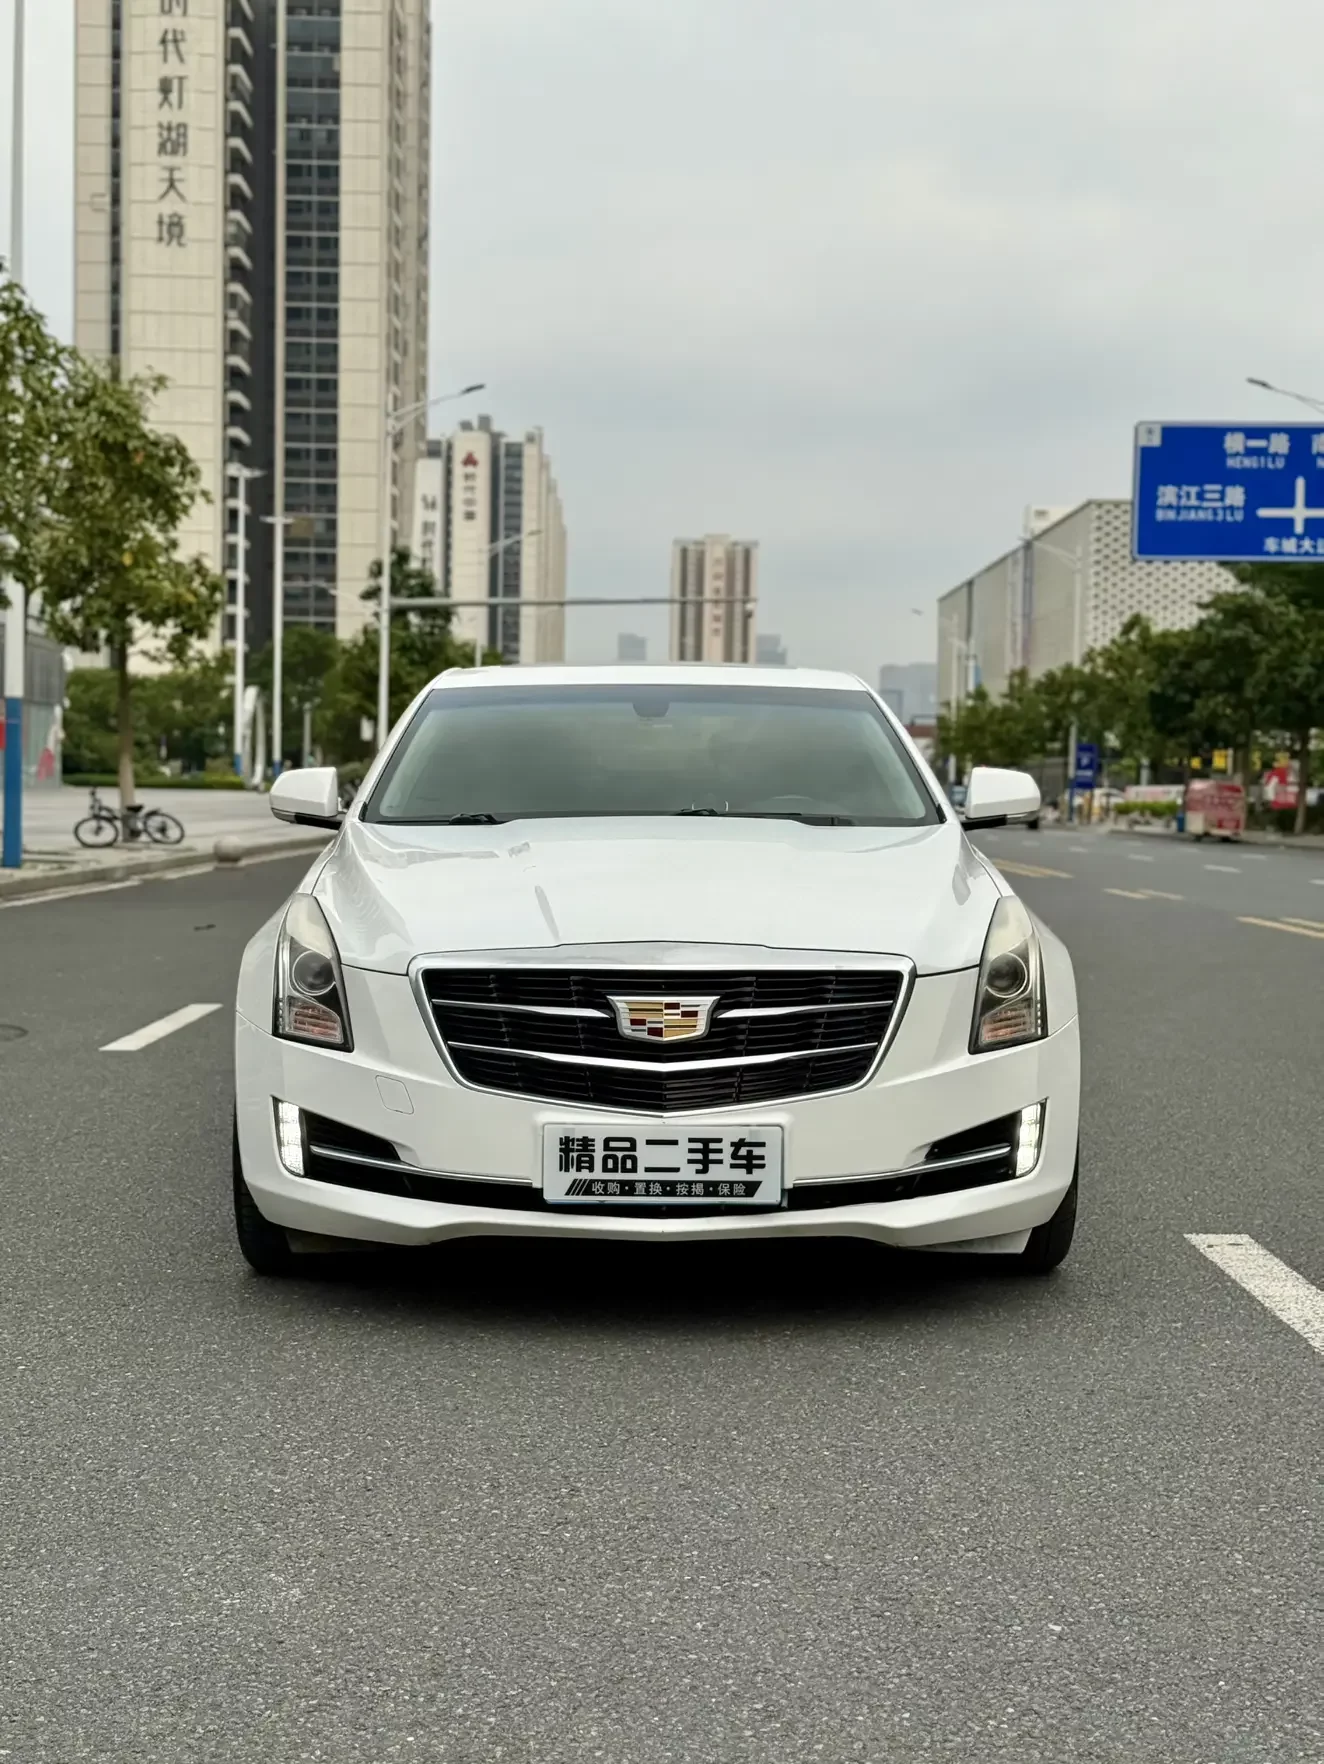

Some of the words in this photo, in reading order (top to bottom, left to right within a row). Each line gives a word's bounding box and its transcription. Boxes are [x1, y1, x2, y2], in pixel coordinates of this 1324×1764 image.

[1156, 484, 1246, 508] 滨江三路
[559, 1135, 767, 1175] 精品二手车
